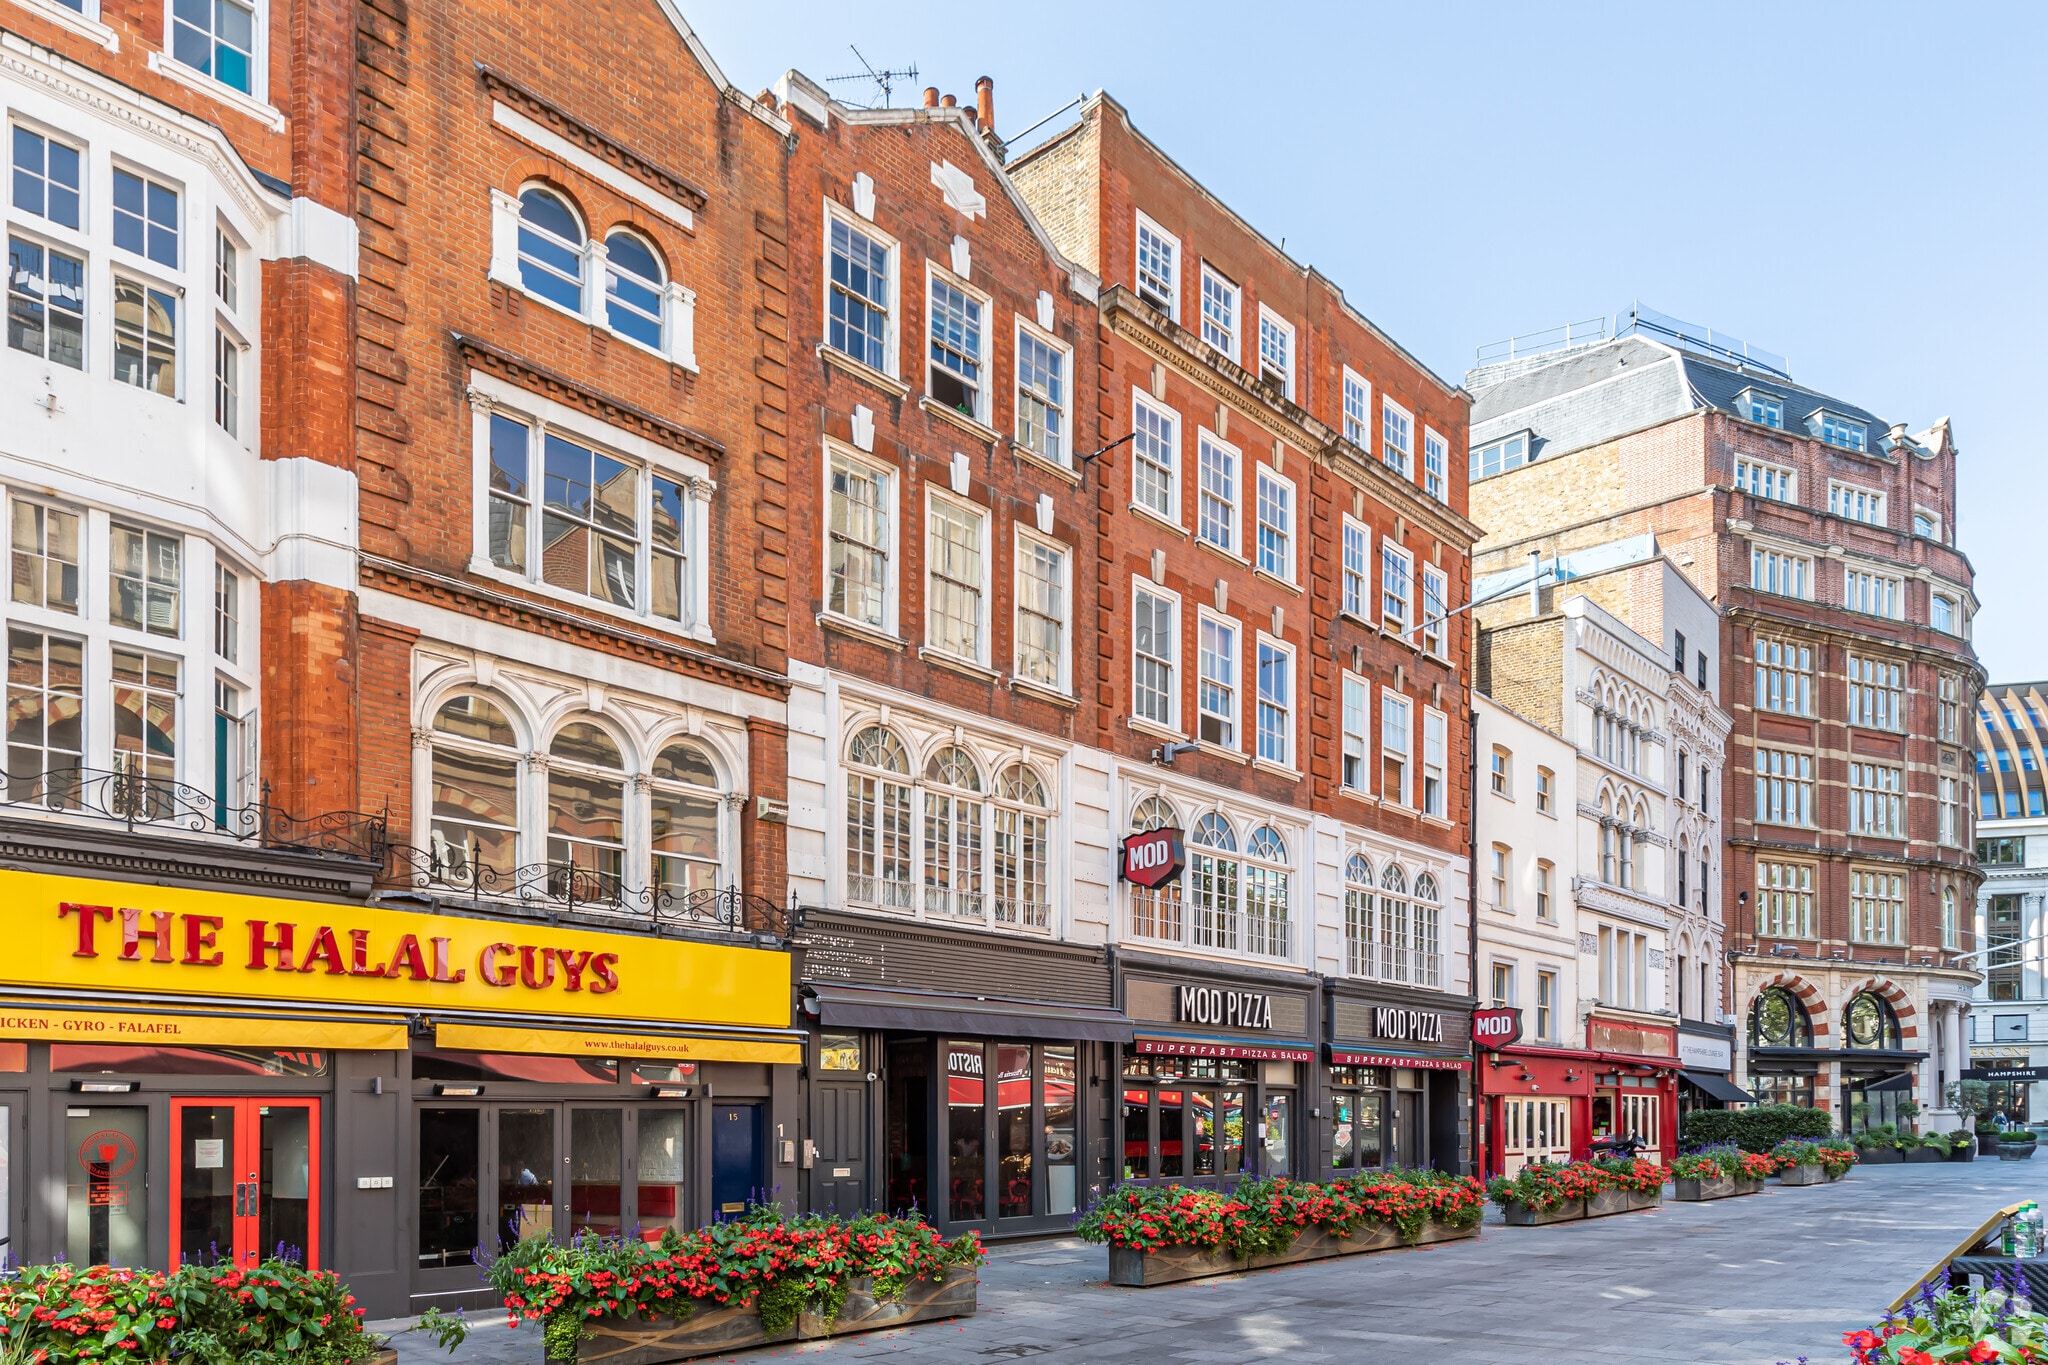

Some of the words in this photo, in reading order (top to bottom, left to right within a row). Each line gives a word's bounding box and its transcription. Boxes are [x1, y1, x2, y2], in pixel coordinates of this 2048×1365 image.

[1130, 840, 1168, 872] MOD
[58, 902, 224, 966] THE
[245, 919, 465, 983] HALAL
[479, 942, 619, 994] GUYS
[1180, 985, 1222, 1024] MOD
[1227, 991, 1273, 1029] PIZZA
[62, 1019, 105, 1032] GYRO
[118, 1022, 181, 1034] FALAFEL
[1376, 1007, 1406, 1039] MOD
[1409, 1011, 1443, 1043] PIZZA
[1477, 1015, 1512, 1036] MOD
[584, 1040, 690, 1053] www.thehalalguys.co.uk
[1145, 1043, 1236, 1056] SUPERFAST
[1242, 1049, 1268, 1058] PIZZA
[1271, 1051, 1277, 1059] &
[1280, 1051, 1308, 1061] SALAD
[1346, 1055, 1411, 1066] SUPERFAST
[1414, 1060, 1434, 1068] PIZZA
[1442, 1061, 1462, 1069] SALAD
[1987, 1070, 2037, 1078] HAMPSHIRE
[728, 1113, 739, 1121] 15
[777, 1123, 784, 1138] 1
